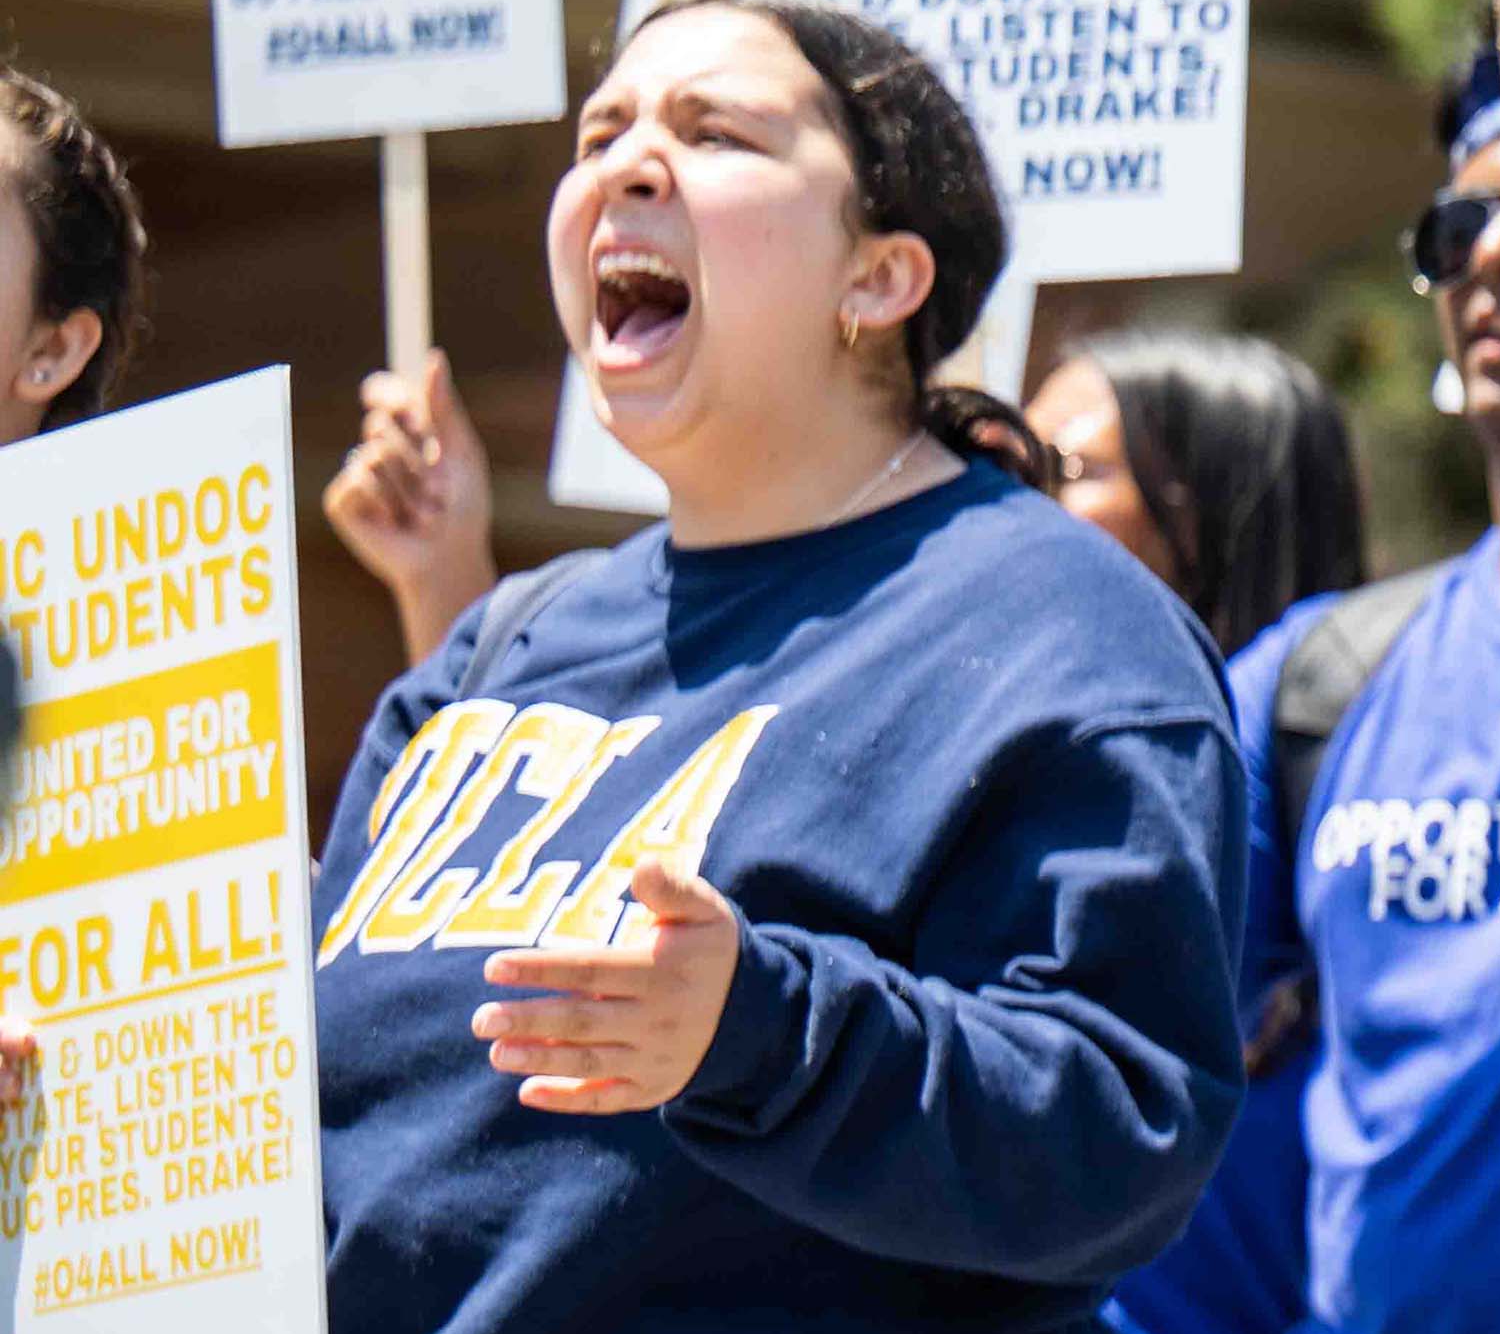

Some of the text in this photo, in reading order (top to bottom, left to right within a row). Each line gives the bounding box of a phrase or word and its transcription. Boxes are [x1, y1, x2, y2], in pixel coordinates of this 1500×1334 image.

[951, 4, 1138, 45] LISTEN
[957, 43, 1210, 87] TUDENTS,
[1019, 68, 1220, 129] DRAKE!
[1022, 147, 1163, 196] NOW!
[72, 463, 272, 582] UNDOC
[9, 546, 272, 682] TUDENTS
[166, 689, 251, 763] FOR
[316, 698, 781, 972] UCLA
[1368, 853, 1490, 924] FOR
[0, 870, 282, 1017] FOR ALL!
[60, 1035, 82, 1080] &
[94, 1000, 196, 1073] DOWN
[206, 990, 278, 1043] THE
[114, 1048, 236, 1118] LISTEN
[249, 1035, 297, 1085] TO
[0, 1089, 294, 1193] YOUR STUDENTS,
[1, 1137, 293, 1241] UC PRES. DRAKE!
[170, 1216, 263, 1278] NOW!
